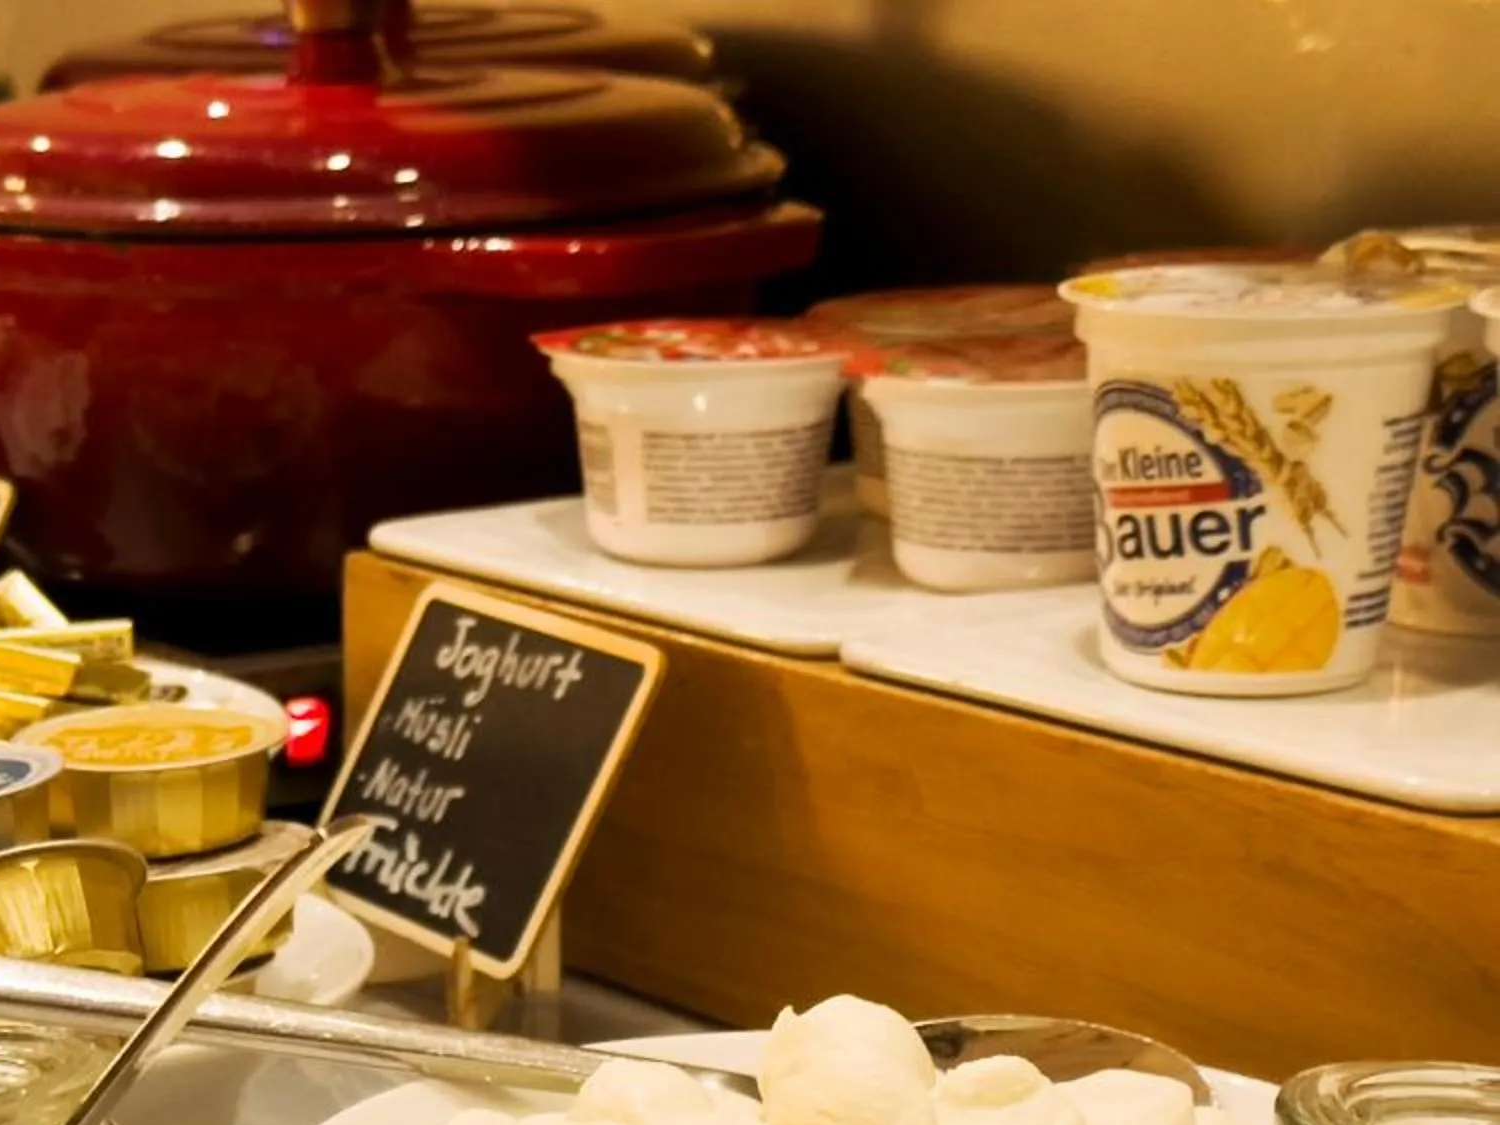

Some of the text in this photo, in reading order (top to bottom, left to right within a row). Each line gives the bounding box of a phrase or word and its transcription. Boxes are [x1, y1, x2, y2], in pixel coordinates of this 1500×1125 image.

[1118, 447, 1203, 480] Kleine
[1098, 504, 1266, 567] auer
[436, 617, 584, 706] Joghurt
